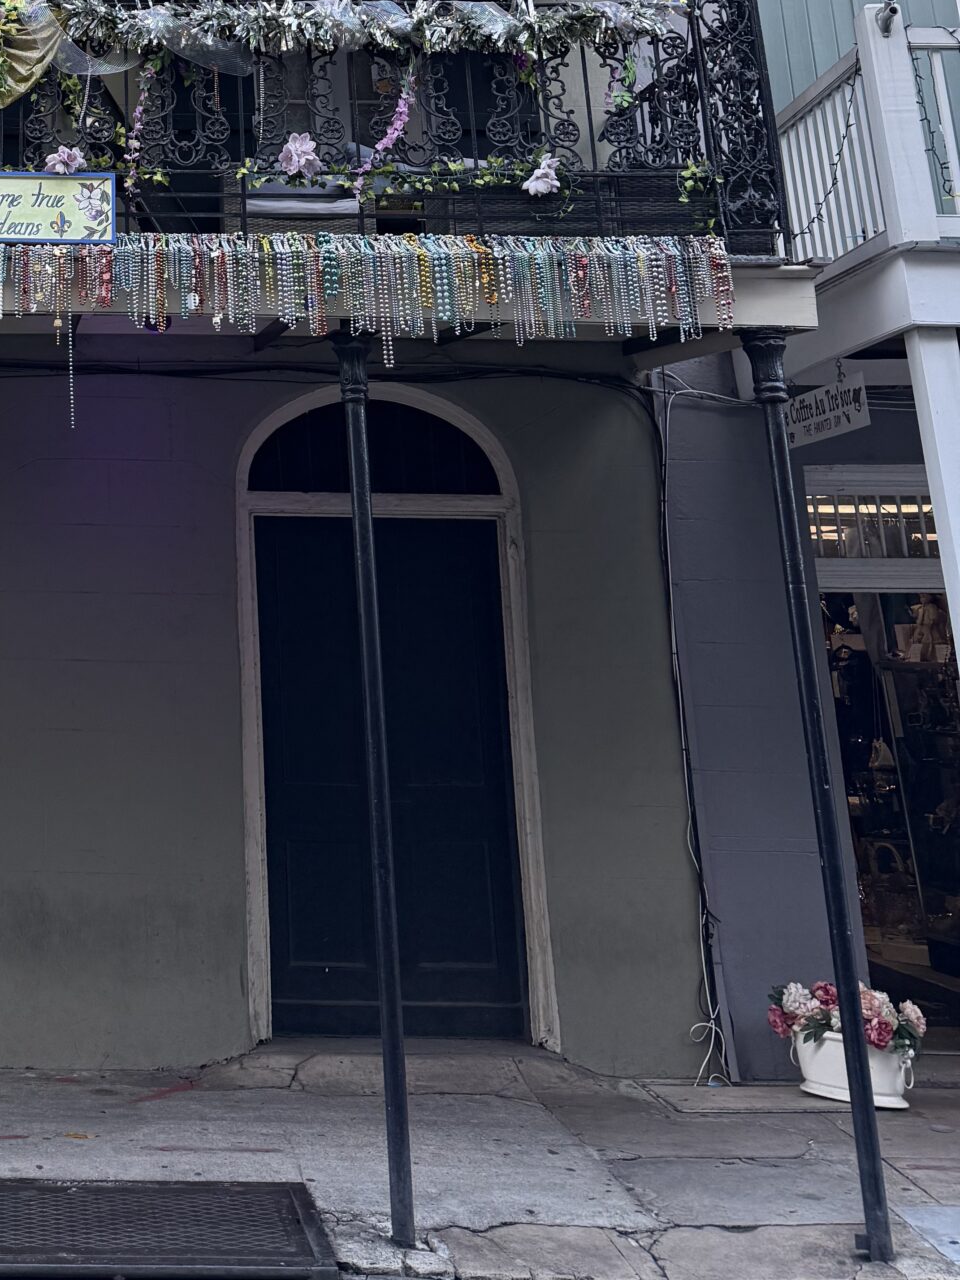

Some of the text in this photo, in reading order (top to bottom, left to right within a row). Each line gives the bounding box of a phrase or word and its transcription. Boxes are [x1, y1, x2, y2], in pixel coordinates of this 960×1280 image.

[31, 181, 65, 208] true
[790, 398, 814, 425] Coffre
[814, 394, 826, 417] Au
